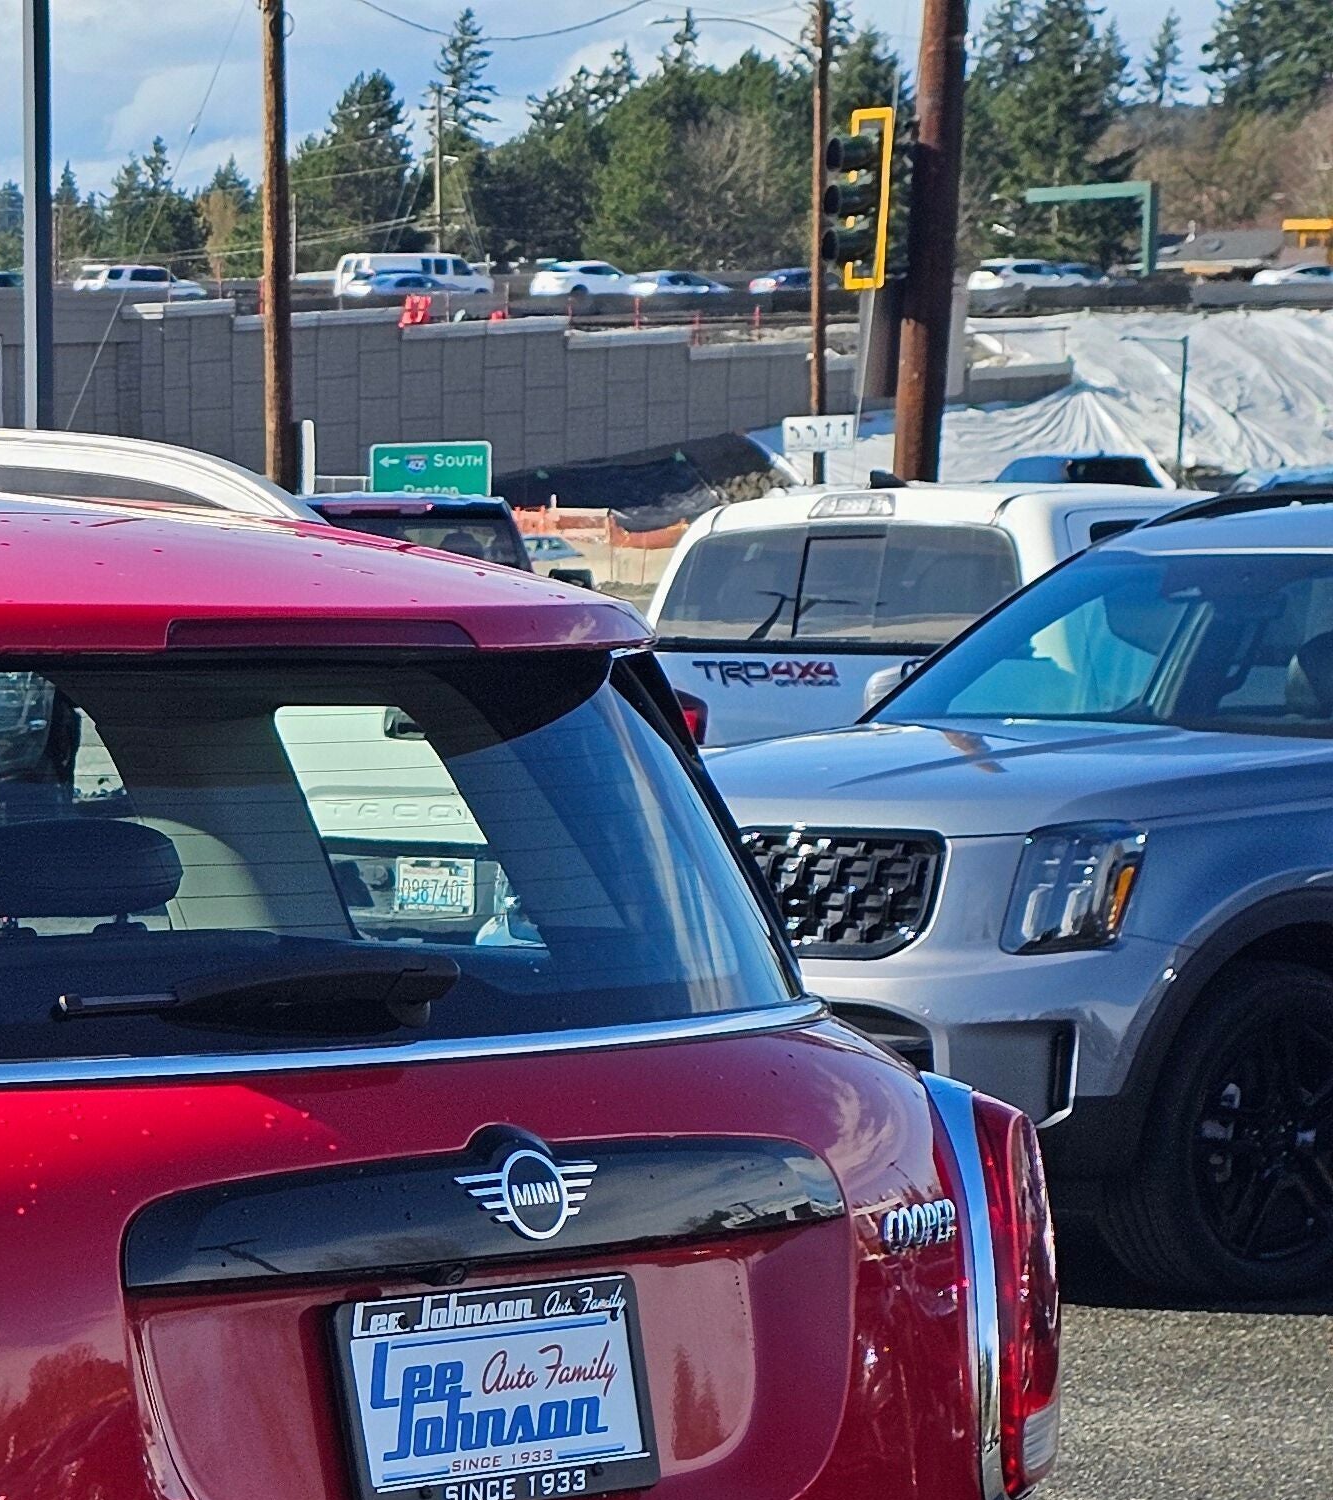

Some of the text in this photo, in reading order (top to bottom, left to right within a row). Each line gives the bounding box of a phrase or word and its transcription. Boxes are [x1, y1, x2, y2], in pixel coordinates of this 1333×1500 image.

[433, 453, 484, 468] SOUTH
[324, 801, 468, 821] TACO
[511, 1180, 561, 1207] MINI
[884, 1198, 957, 1246] COOPER
[353, 1301, 411, 1338] Lee
[413, 1292, 538, 1331] Johnson
[370, 1341, 472, 1409] Lee
[481, 1340, 619, 1397] Auto Family
[383, 1390, 609, 1462] Johnson
[451, 1448, 554, 1473] SINCE 1933
[528, 1468, 586, 1497] 1933
